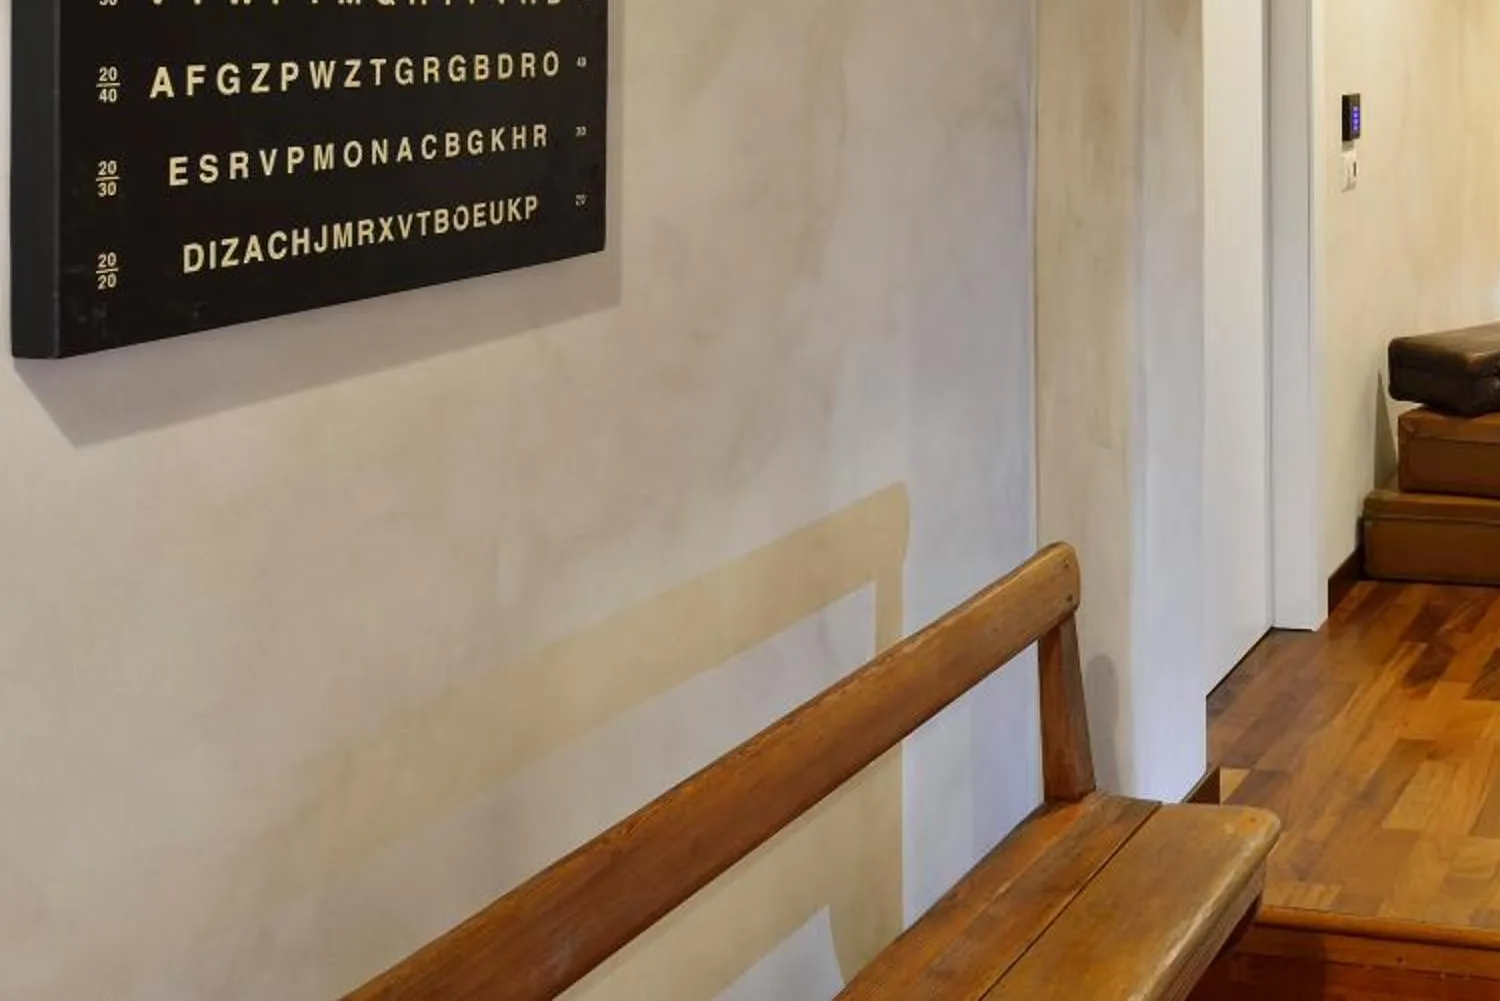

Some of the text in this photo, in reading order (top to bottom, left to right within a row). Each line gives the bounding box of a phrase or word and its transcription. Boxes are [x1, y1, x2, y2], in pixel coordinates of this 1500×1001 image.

[99, 66, 118, 82] 20
[99, 87, 118, 104] 40
[98, 159, 118, 176] 20
[98, 181, 117, 198] 30
[184, 194, 538, 274] DIZACHJMRXVTBOEUKP
[98, 251, 117, 269] 20
[98, 272, 117, 290] 20
